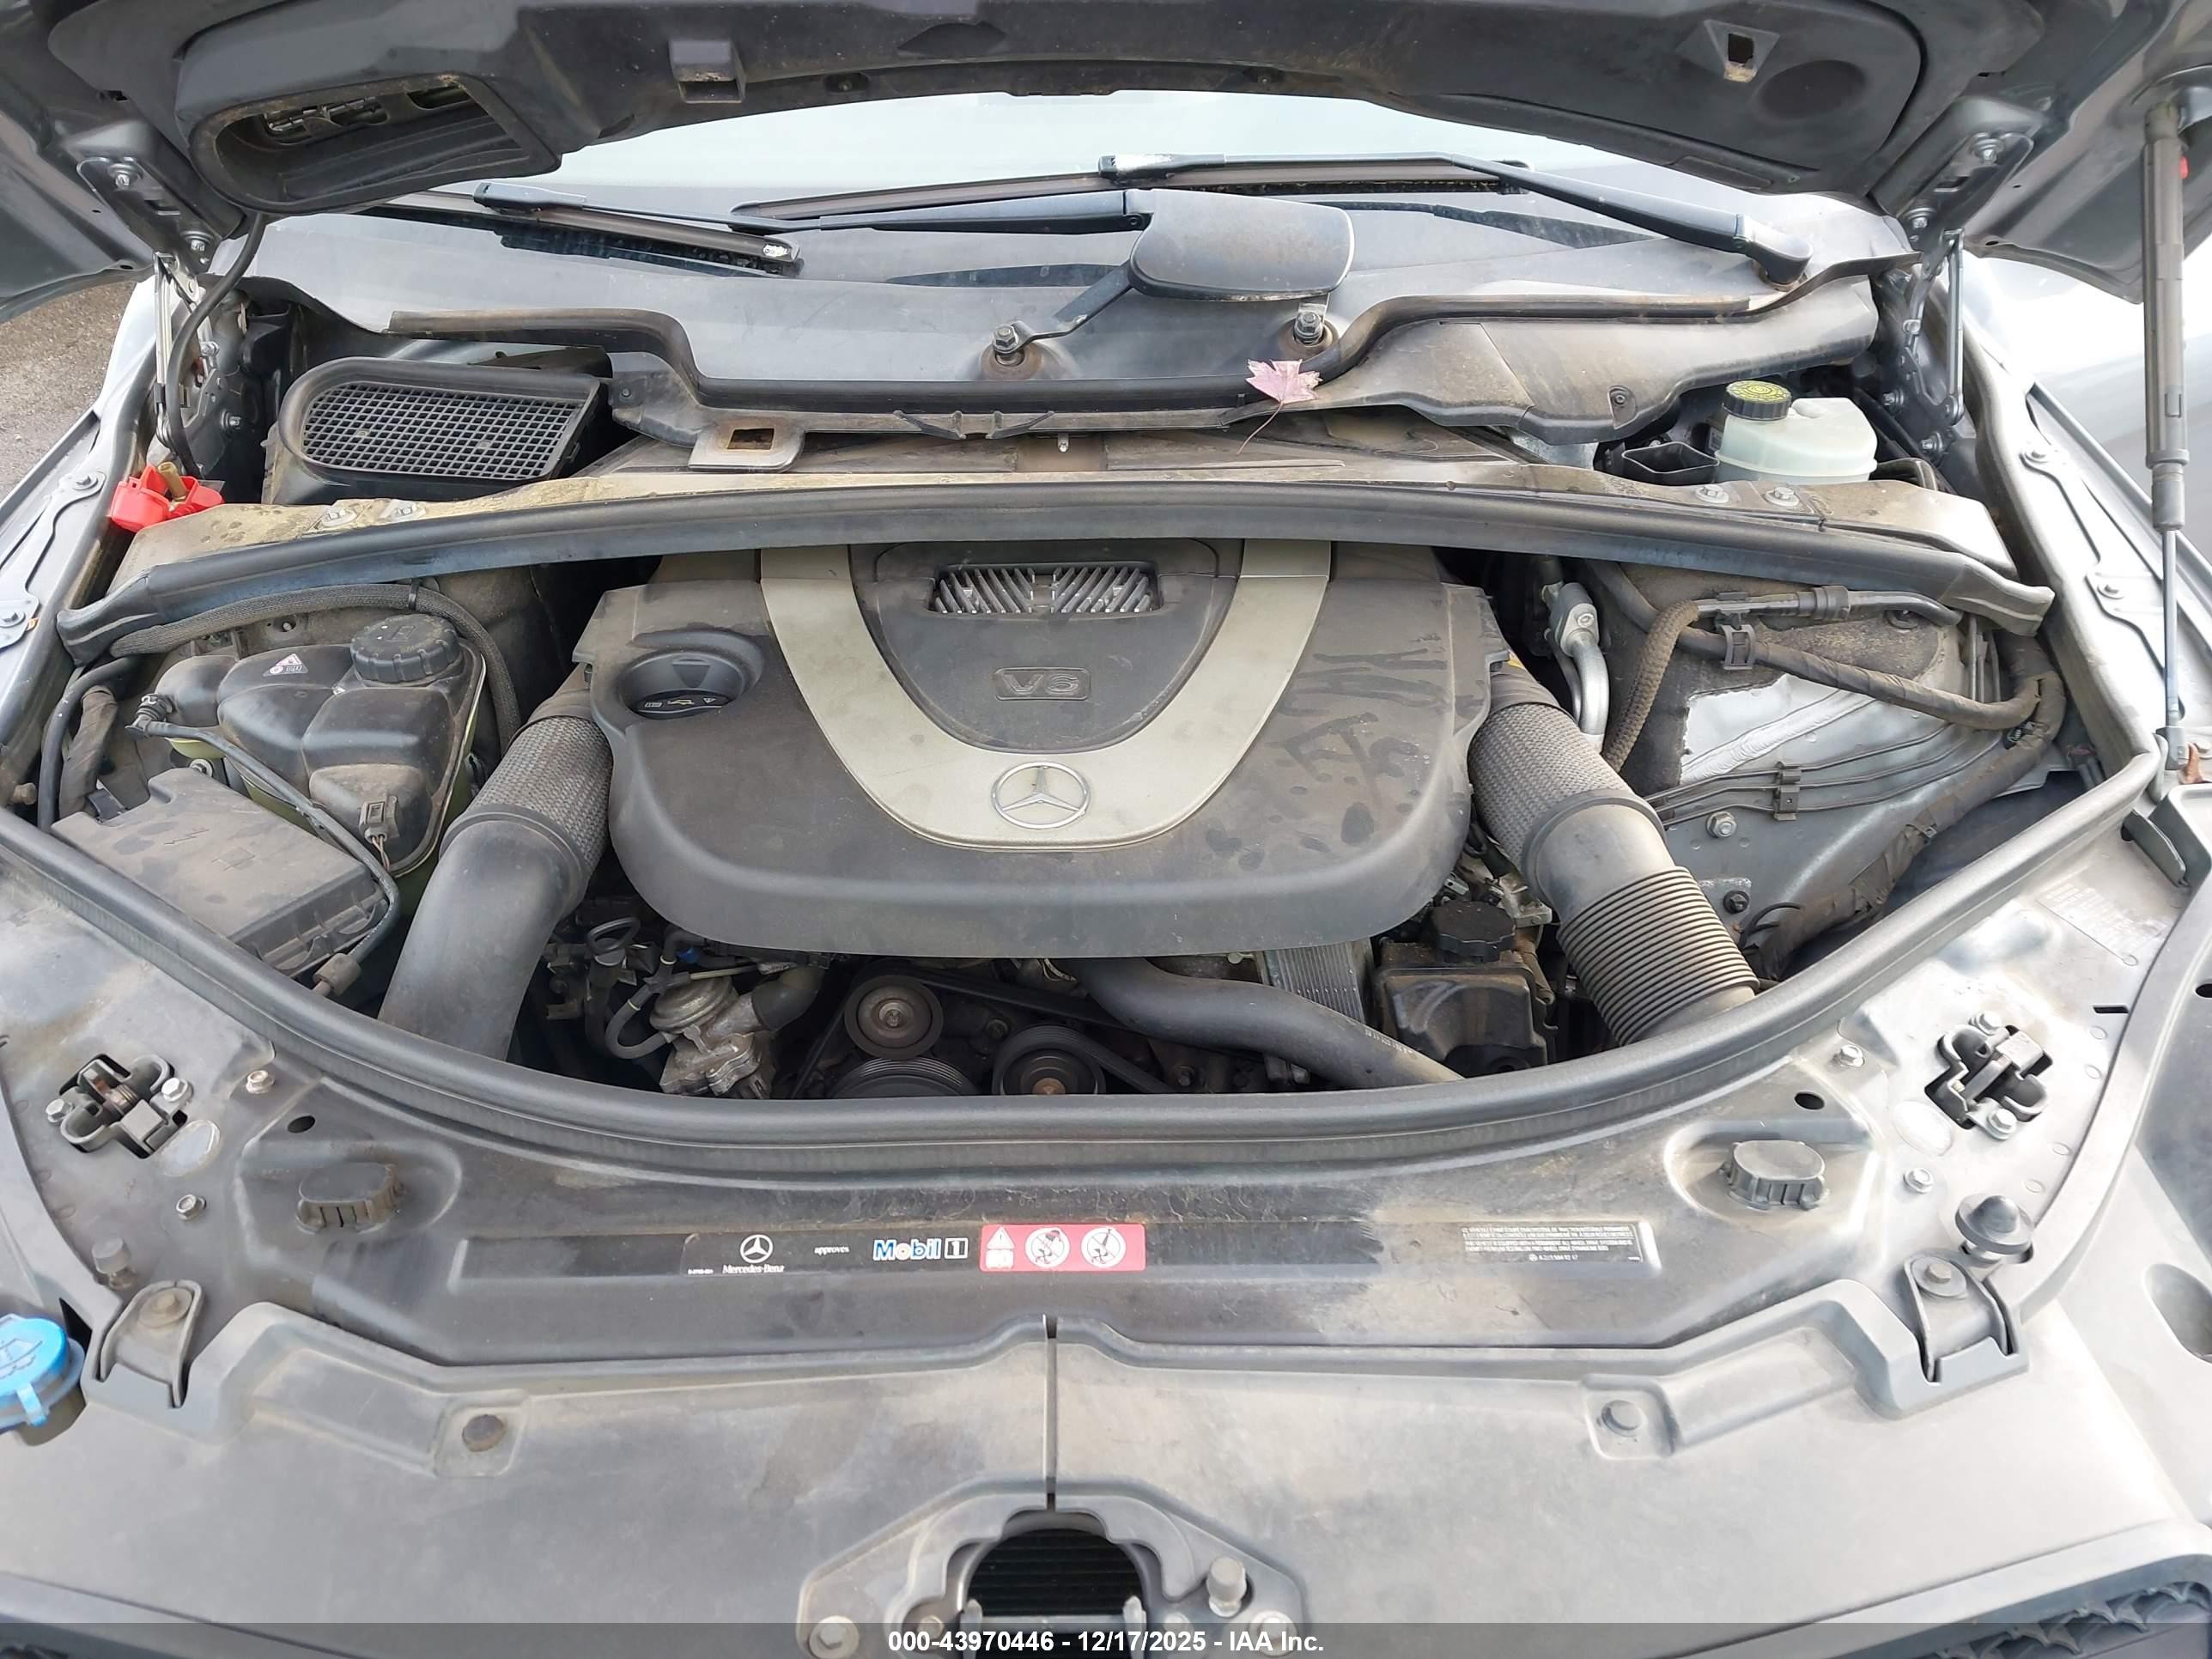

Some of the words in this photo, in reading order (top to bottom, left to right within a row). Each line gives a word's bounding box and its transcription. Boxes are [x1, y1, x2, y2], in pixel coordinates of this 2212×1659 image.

[1001, 673, 1079, 695] V6
[873, 1238, 942, 1261] Mobil
[722, 1263, 785, 1274] Mercedes-Benz
